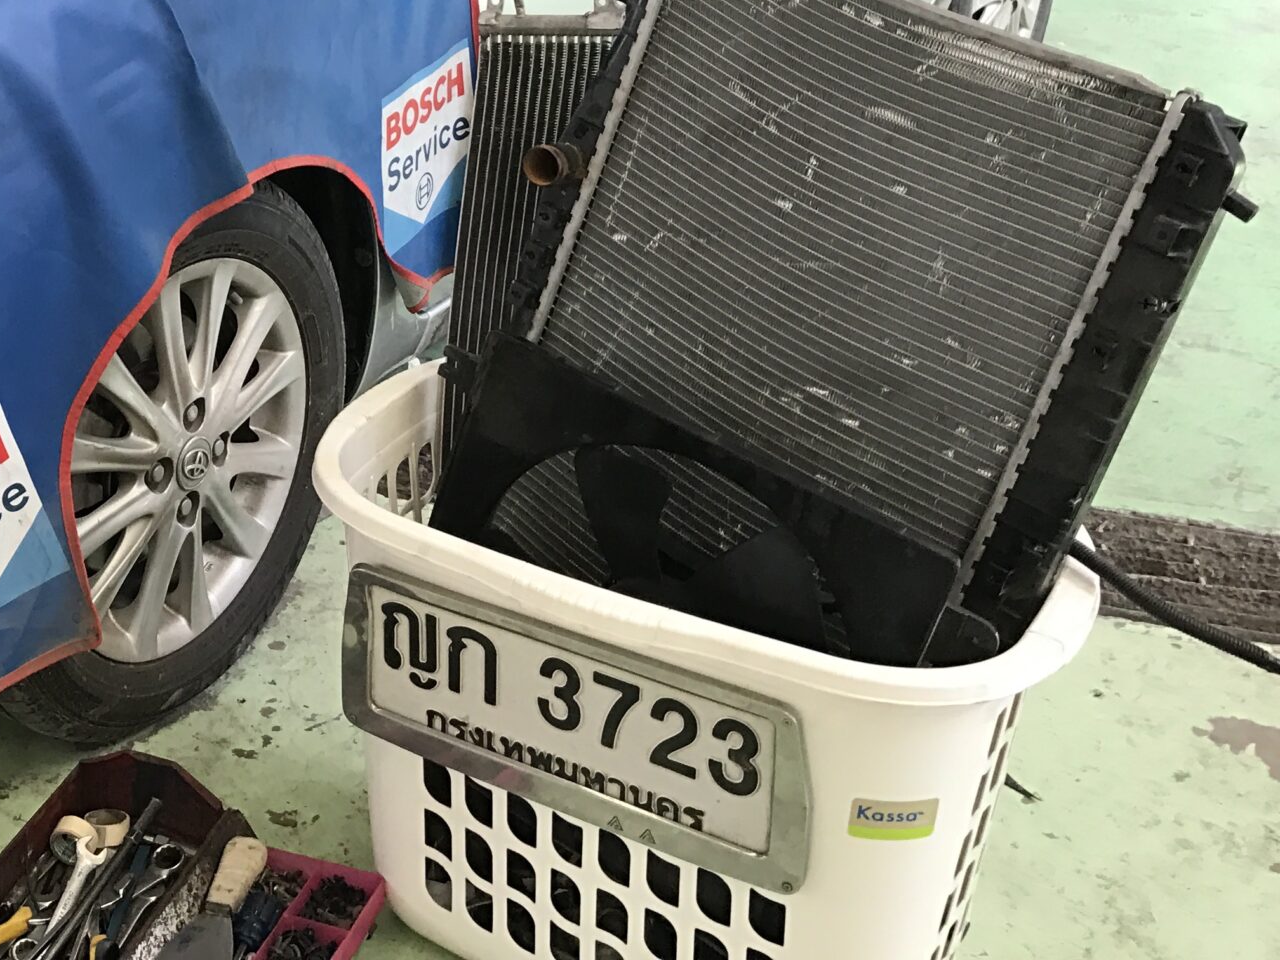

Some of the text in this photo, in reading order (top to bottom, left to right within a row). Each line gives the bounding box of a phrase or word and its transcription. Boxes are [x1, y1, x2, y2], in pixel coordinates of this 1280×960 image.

[386, 62, 465, 152] BOSCH
[388, 116, 470, 192] Service
[381, 601, 761, 797] ญก 3723
[426, 709, 706, 833] กรงเทพมหานคร
[856, 804, 919, 822] Kassa
